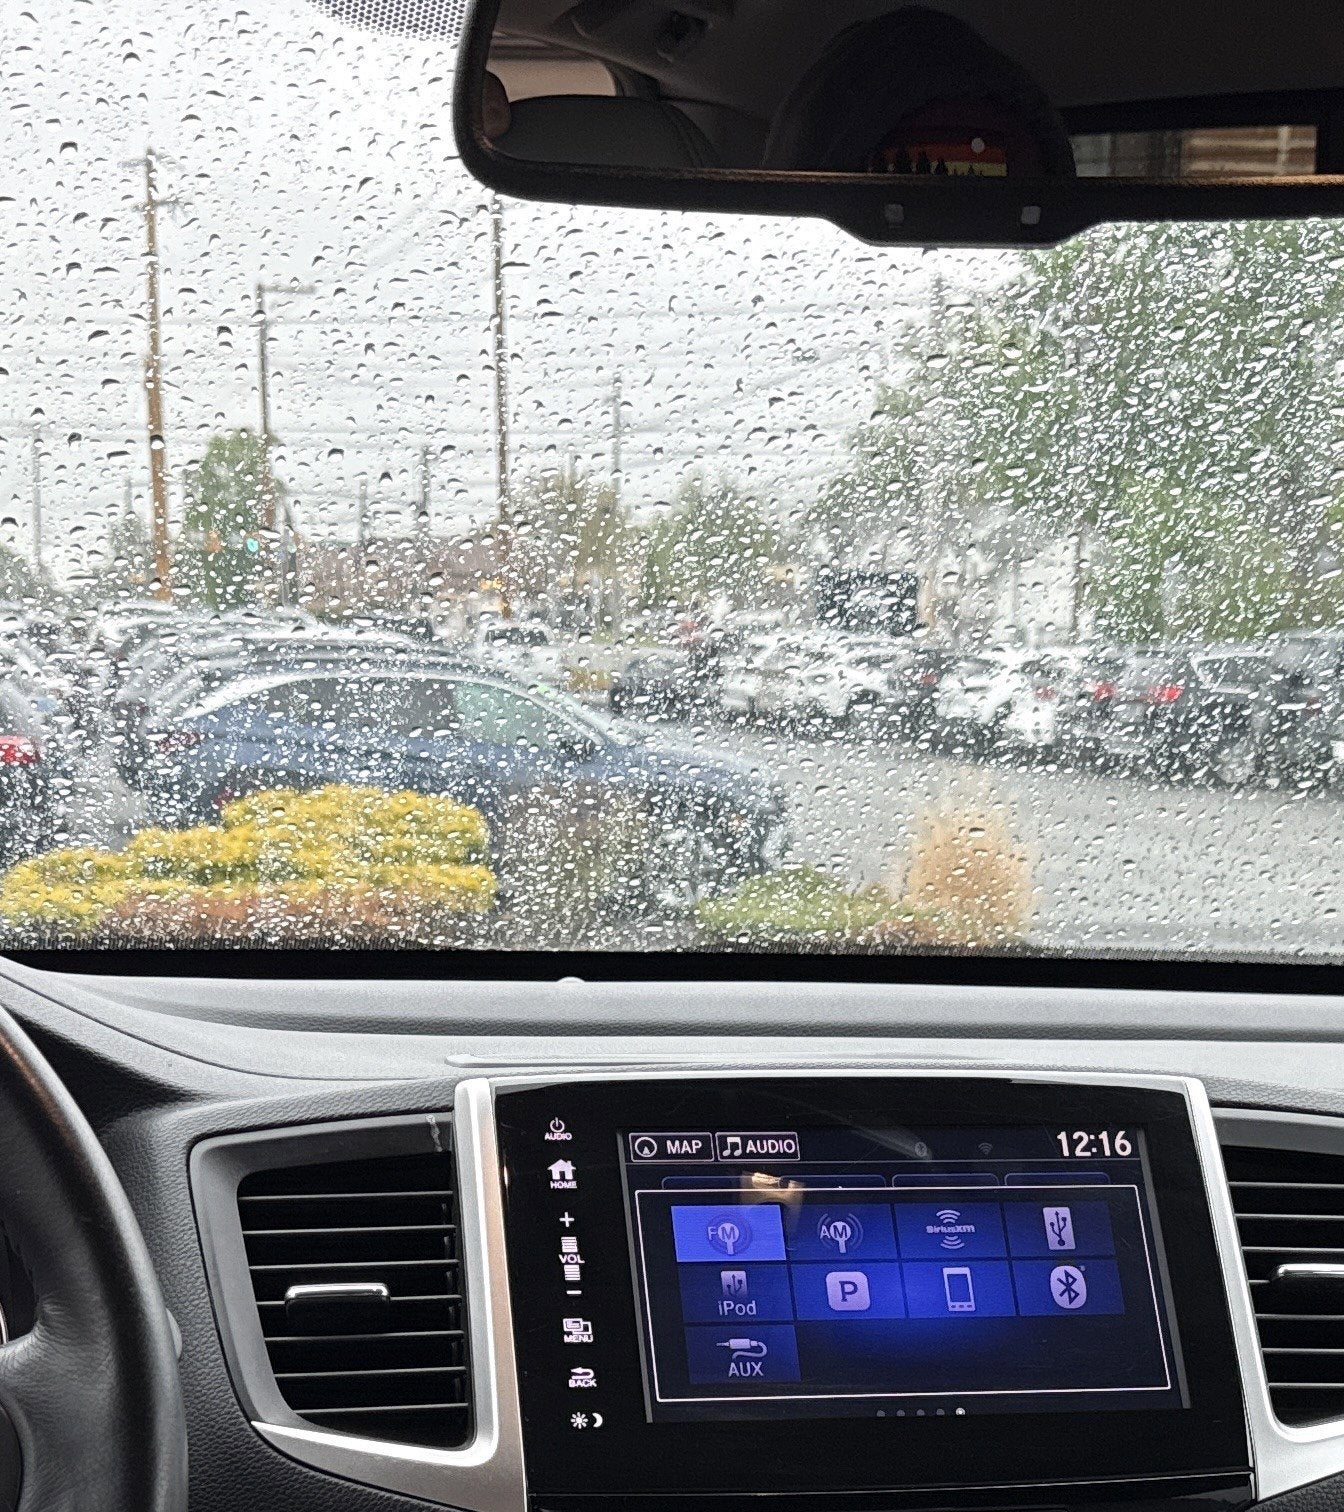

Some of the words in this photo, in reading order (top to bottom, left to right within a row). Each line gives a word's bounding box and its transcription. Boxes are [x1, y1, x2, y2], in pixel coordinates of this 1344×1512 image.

[544, 1132, 573, 1141] AUDIO
[1057, 1130, 1132, 1157] 12:16
[666, 1140, 702, 1155] MAP
[746, 1139, 796, 1154] AUDIO
[550, 1180, 577, 1189] HOME
[707, 1225, 736, 1241] FM
[819, 1223, 848, 1240] AM
[558, 1253, 585, 1264] VOL
[718, 1300, 757, 1316] iPod
[563, 1334, 594, 1343] MENU
[728, 1361, 764, 1378] AUX
[568, 1379, 597, 1388] BACK
